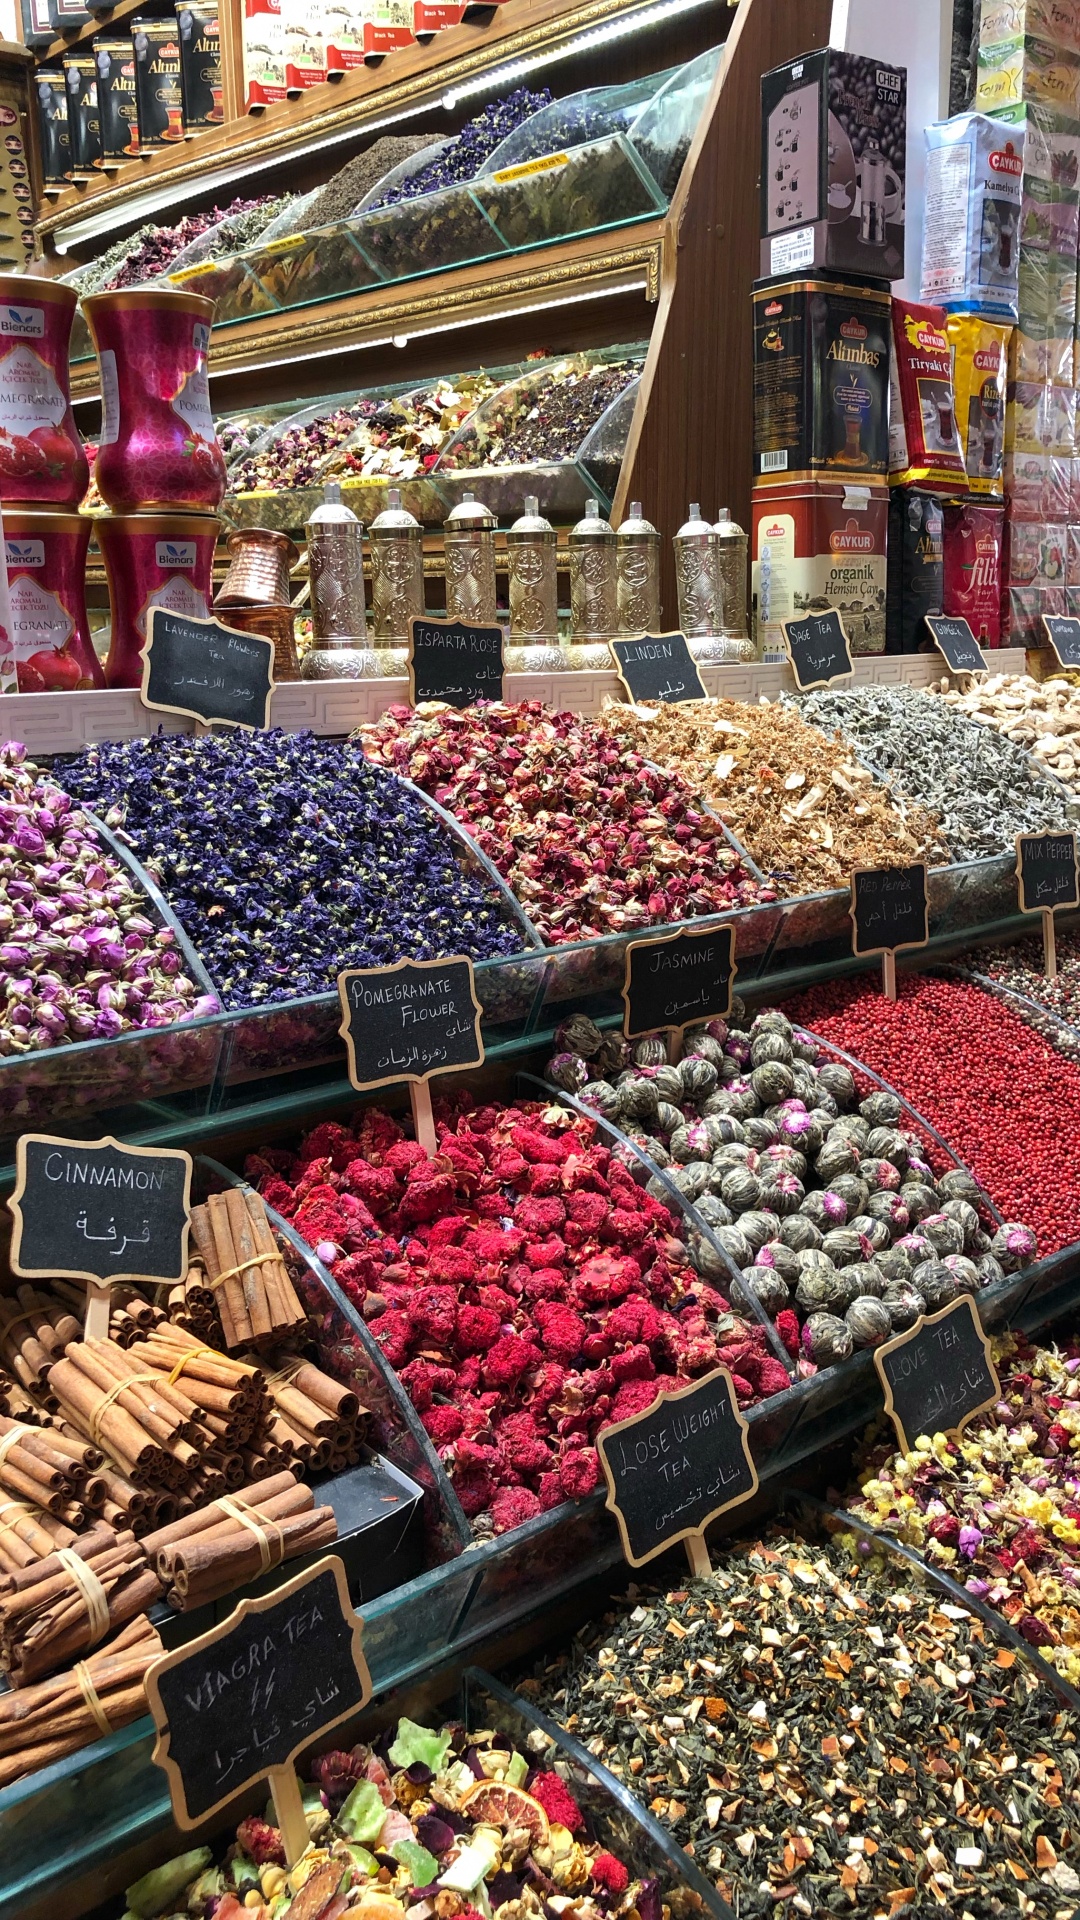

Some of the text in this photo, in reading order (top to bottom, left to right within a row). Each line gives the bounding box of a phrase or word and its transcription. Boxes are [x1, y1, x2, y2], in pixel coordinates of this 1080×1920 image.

[878, 72, 900, 89] CHEF
[877, 88, 899, 105] STAR
[1, 321, 42, 334] Bienars
[825, 339, 881, 369] Altınbaş
[907, 357, 942, 373] Tiryaki
[0, 393, 64, 408] MEGRANATE
[159, 555, 194, 564] Bienars
[830, 563, 874, 584] organik
[823, 581, 880, 599] Hemşin Çayı
[13, 620, 70, 631] EGRANATE
[165, 621, 218, 644] LAVENDER
[790, 620, 833, 645] SAGE TEA
[417, 628, 498, 654] ISPARTA ROSE
[625, 643, 672, 664] LINDEN
[1024, 841, 1074, 861] MIX PEPPER
[859, 876, 912, 895] RED PEPPER
[649, 947, 715, 973] JASMINE
[351, 979, 452, 1009] POMEGRANATE
[401, 1001, 459, 1028] FLOWER
[44, 1152, 165, 1191] CINNAMON
[75, 1210, 150, 1256] قرفة
[888, 1325, 961, 1386] LOVE TEA
[620, 1399, 728, 1477] LOSE WEIGHT
[657, 1456, 692, 1483] TEA
[185, 1605, 324, 1712] VIAGRA TEA
